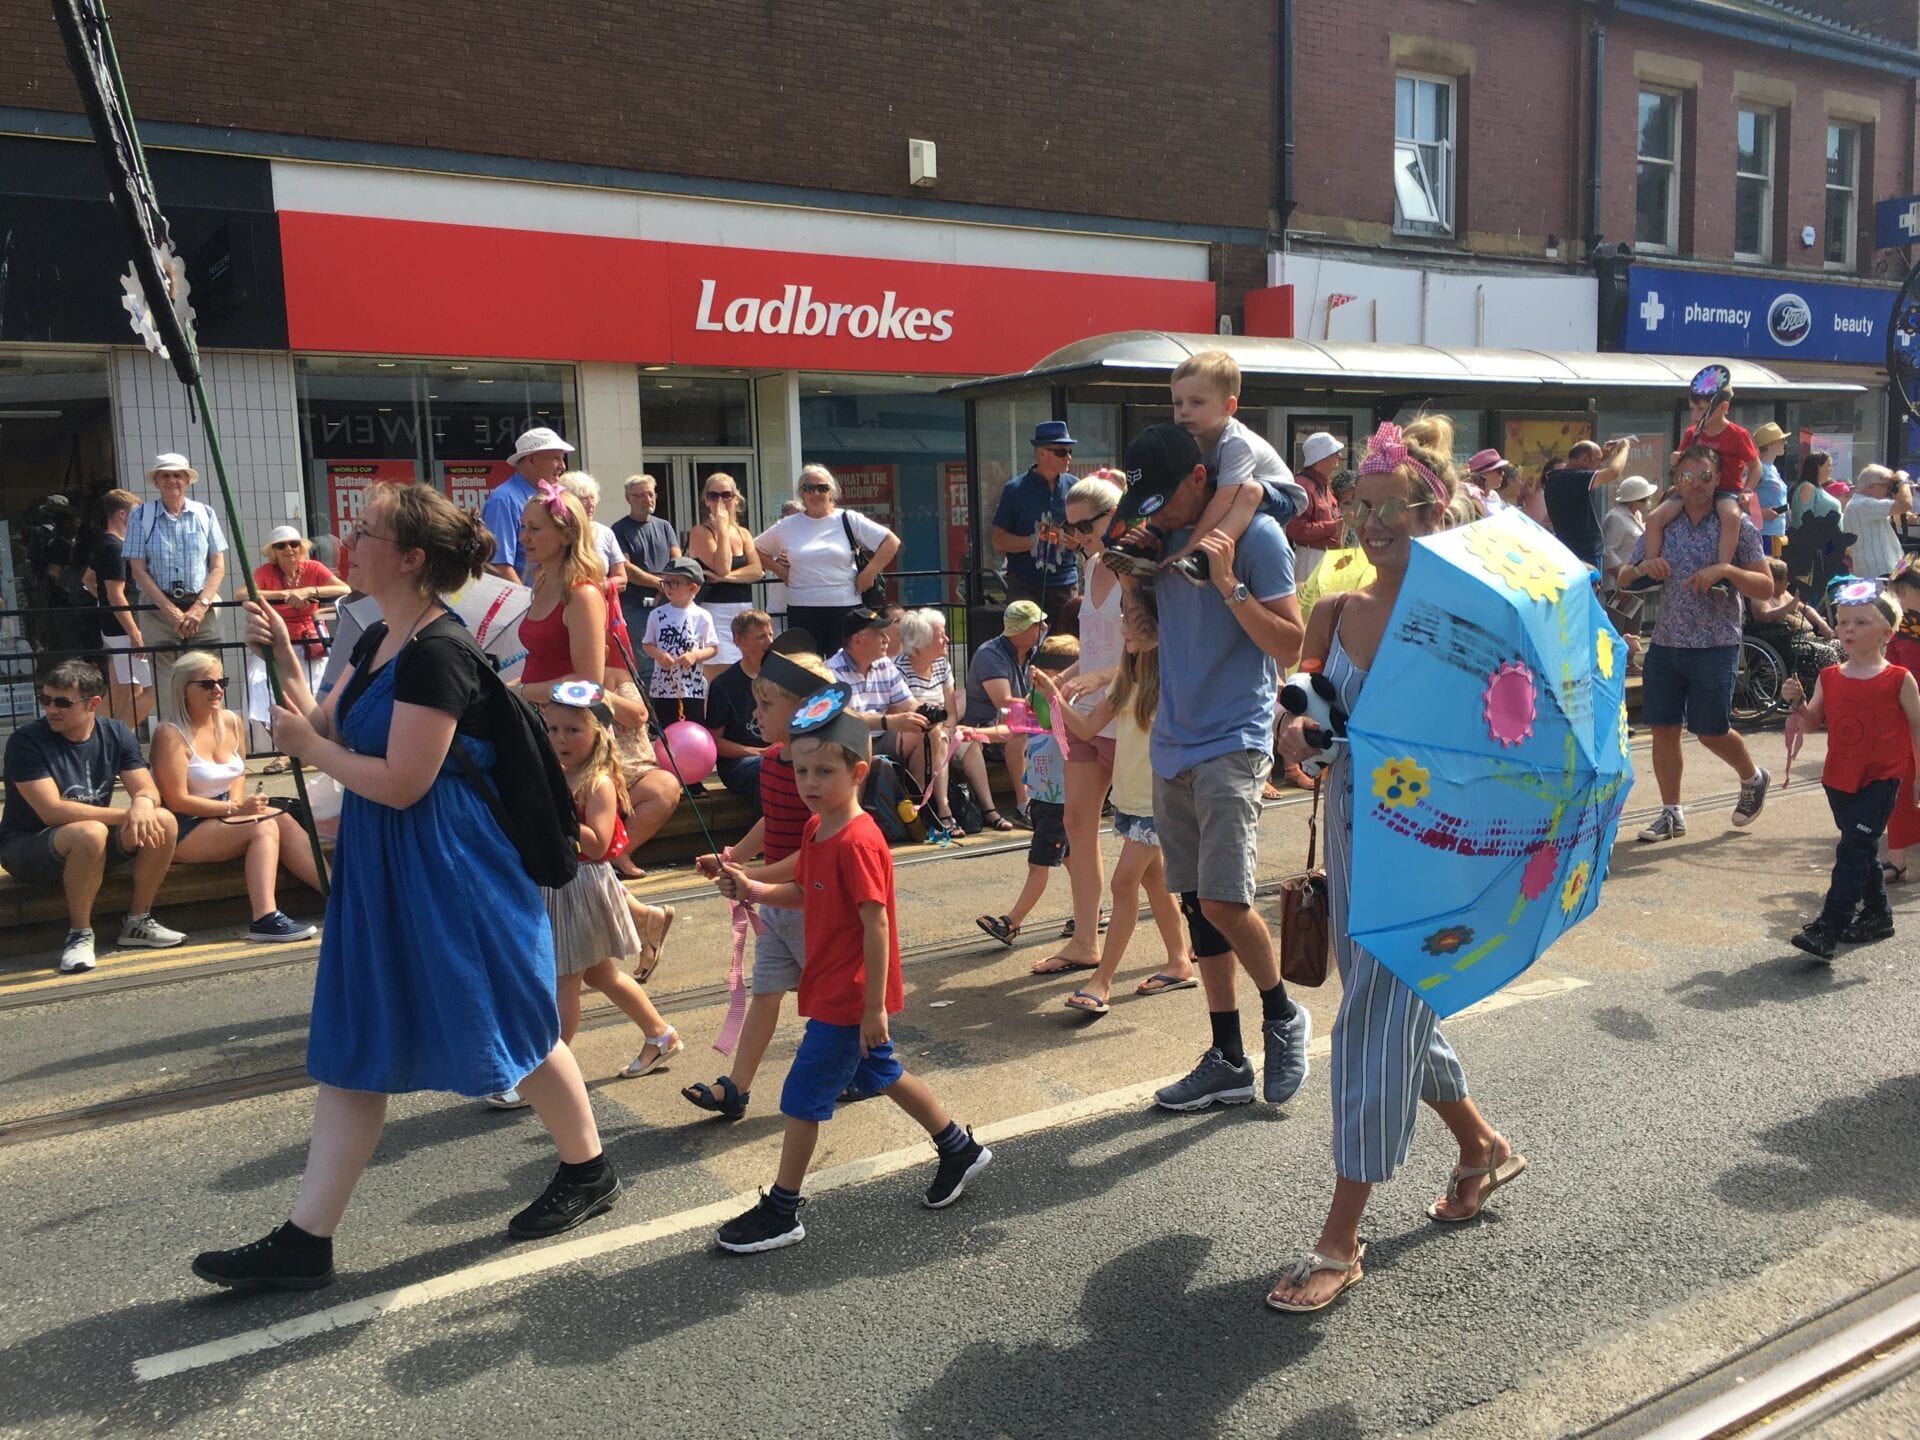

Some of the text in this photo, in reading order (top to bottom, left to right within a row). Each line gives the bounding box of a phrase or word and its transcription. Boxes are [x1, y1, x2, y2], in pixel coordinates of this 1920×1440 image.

[695, 279, 955, 342] Ladbrokes
[1684, 302, 1751, 329] pharmacy
[1777, 306, 1809, 332] Boots
[1834, 314, 1874, 336] beauty
[872, 471, 888, 485] THE
[844, 486, 880, 499] SCORE?
